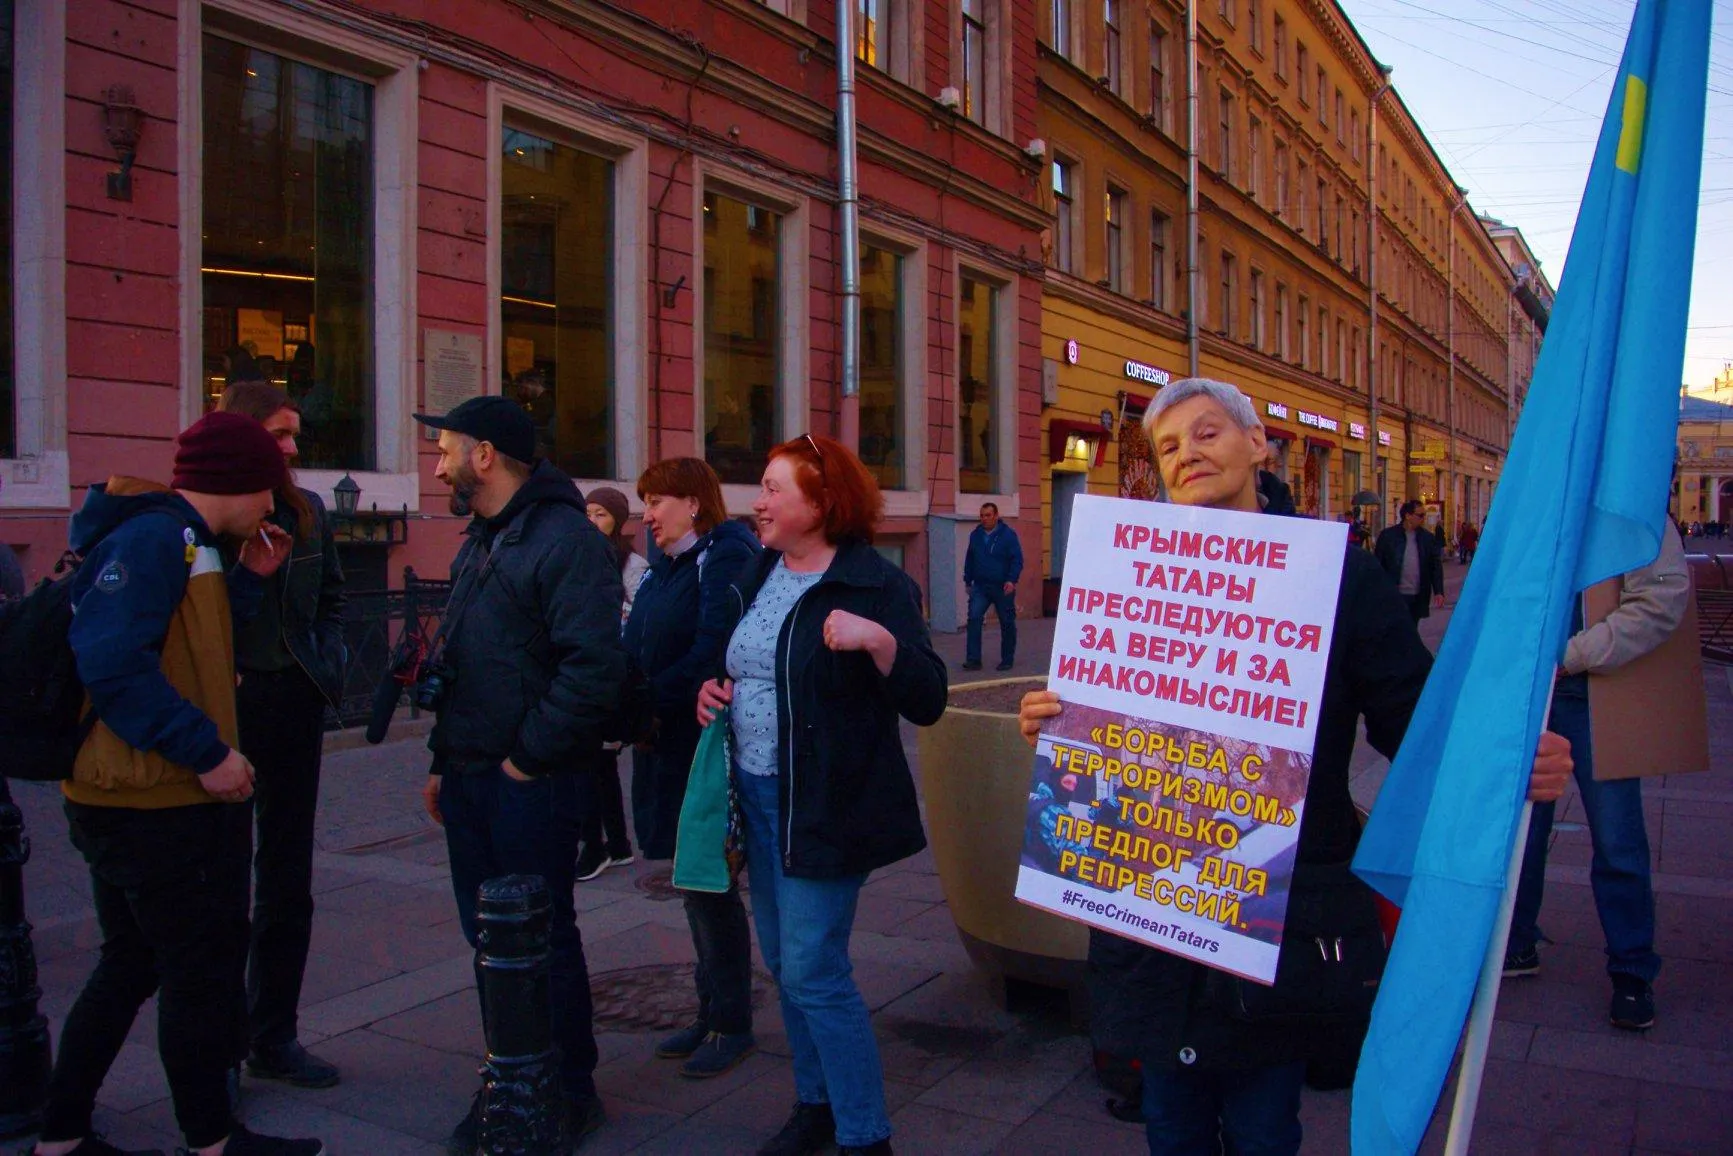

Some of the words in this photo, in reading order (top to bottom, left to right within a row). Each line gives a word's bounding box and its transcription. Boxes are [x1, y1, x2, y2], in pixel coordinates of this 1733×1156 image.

[1126, 361, 1169, 385] COFFEESHOP
[1114, 523, 1288, 570] КРЫМСКИЕ
[1133, 561, 1256, 603] ТАТАРЫ
[1066, 587, 1322, 652] ПРЕСЛЕДУЮТСЯ
[1080, 624, 1116, 654] ЗА
[1126, 632, 1207, 669] ВЕРУ
[1215, 648, 1239, 676] И
[1247, 655, 1291, 687] ЗА
[1057, 655, 1308, 728] ИНАКОМЫСЛИЕ!
[1090, 723, 1229, 775] «БОРЬБА
[1241, 755, 1263, 781] С
[1052, 745, 1297, 828] ТЕРРОРИЗМОМ»
[1118, 797, 1239, 850] ТОЛЬКО
[1055, 814, 1192, 873] ПРЕДЛОГ
[1197, 857, 1269, 897] ДЛЯ
[1060, 851, 1247, 928] РЕПРЕССИЙ.
[1062, 890, 1220, 953] #FreeCrimeanTatars
